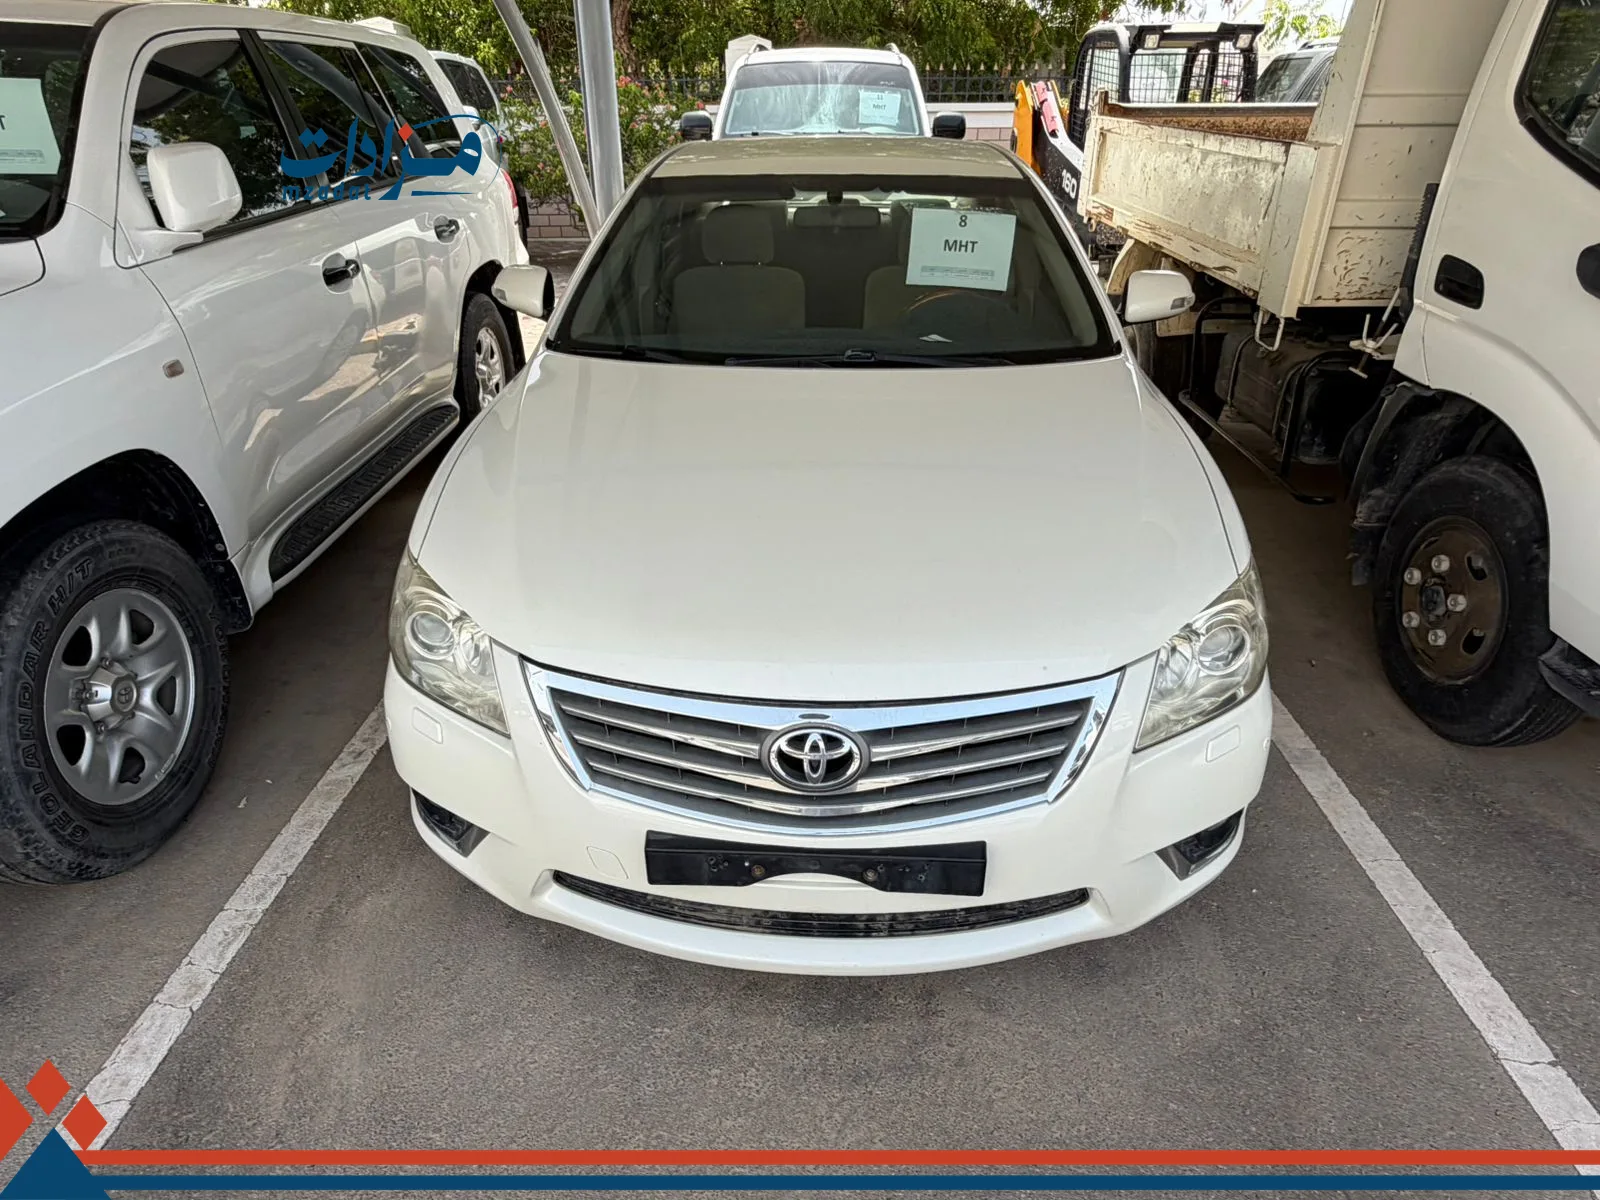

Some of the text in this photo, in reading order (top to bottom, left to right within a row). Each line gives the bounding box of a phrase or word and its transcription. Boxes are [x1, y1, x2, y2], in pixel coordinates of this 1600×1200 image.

[1061, 168, 1078, 200] 160
[958, 214, 969, 228] 8
[943, 238, 979, 254] MHT
[18, 557, 94, 845] GEOLANDAR H/T
